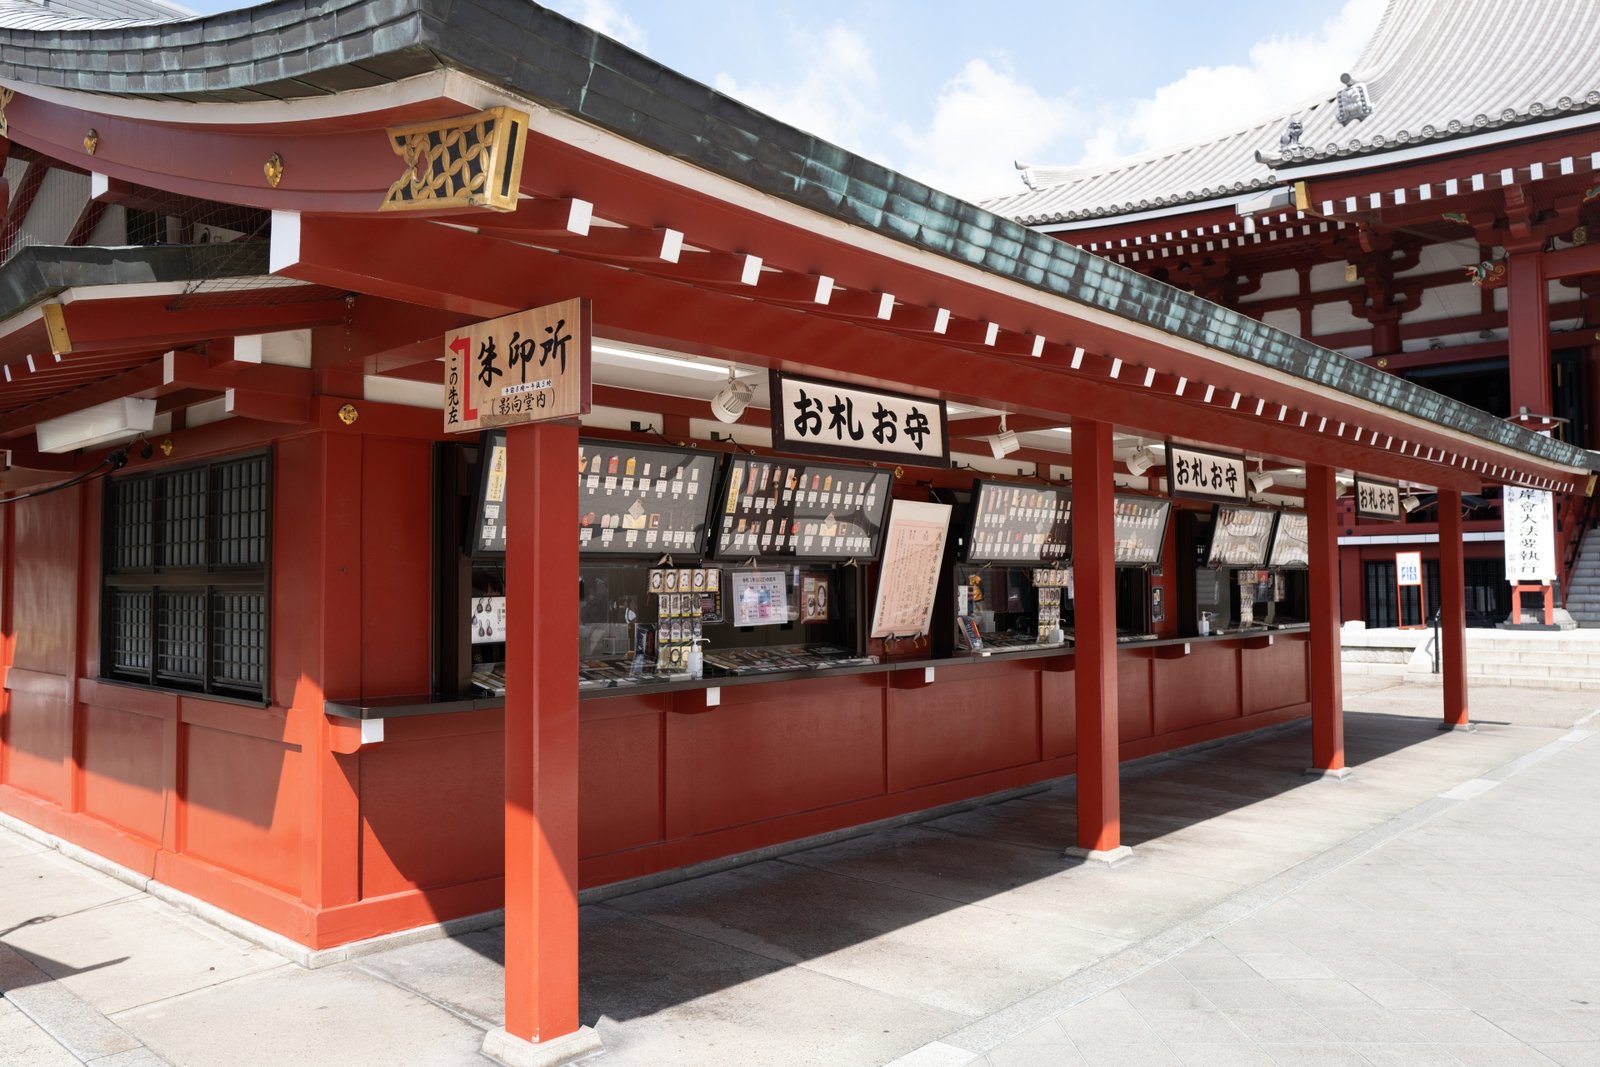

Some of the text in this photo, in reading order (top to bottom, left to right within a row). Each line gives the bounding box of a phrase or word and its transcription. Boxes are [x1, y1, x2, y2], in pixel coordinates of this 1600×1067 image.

[477, 319, 573, 387] 朱印所
[448, 357, 459, 424] この先左
[793, 388, 931, 451] お札お守
[1176, 455, 1238, 493] お札お守
[1359, 488, 1395, 513] お札お守
